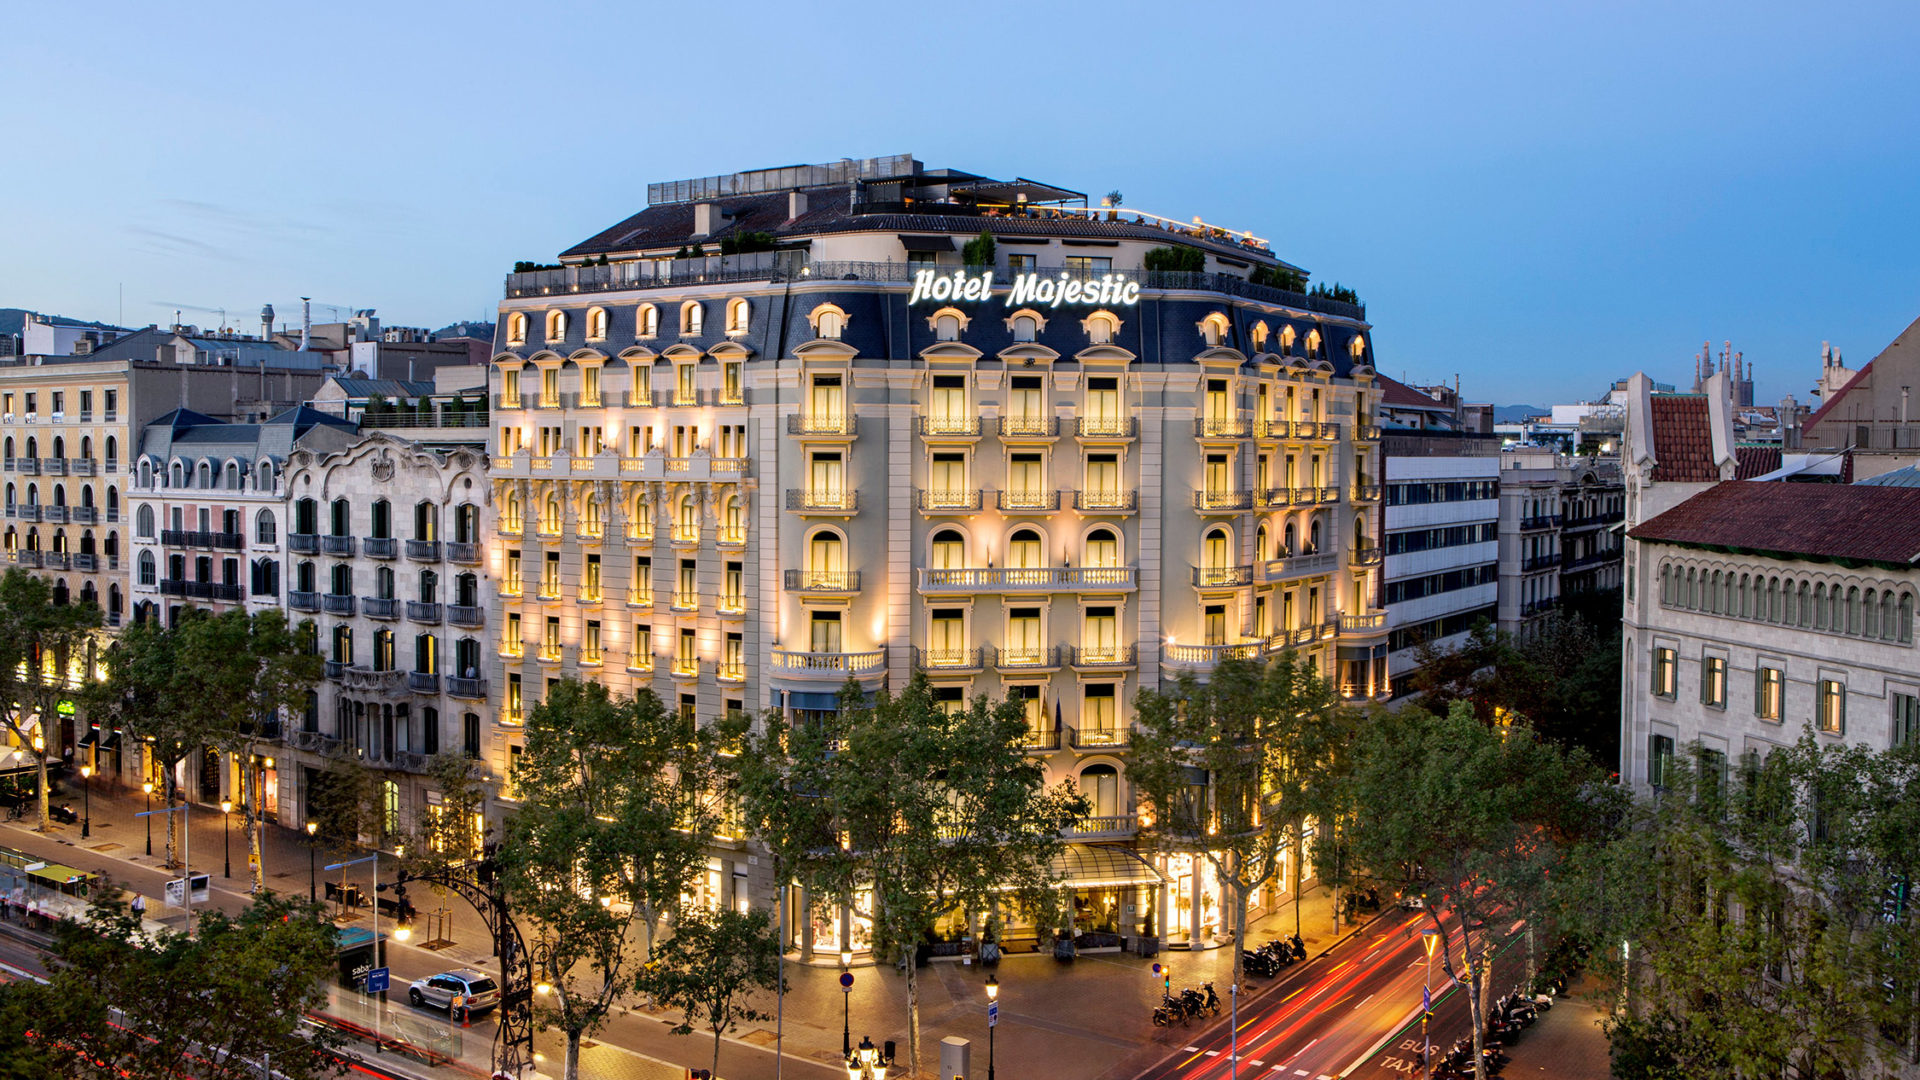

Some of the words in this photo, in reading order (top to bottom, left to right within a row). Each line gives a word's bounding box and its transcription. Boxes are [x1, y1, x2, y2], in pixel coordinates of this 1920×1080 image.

[909, 269, 992, 305] Hotel
[1005, 272, 1140, 308] Majestic
[1399, 1039, 1440, 1056] BUS
